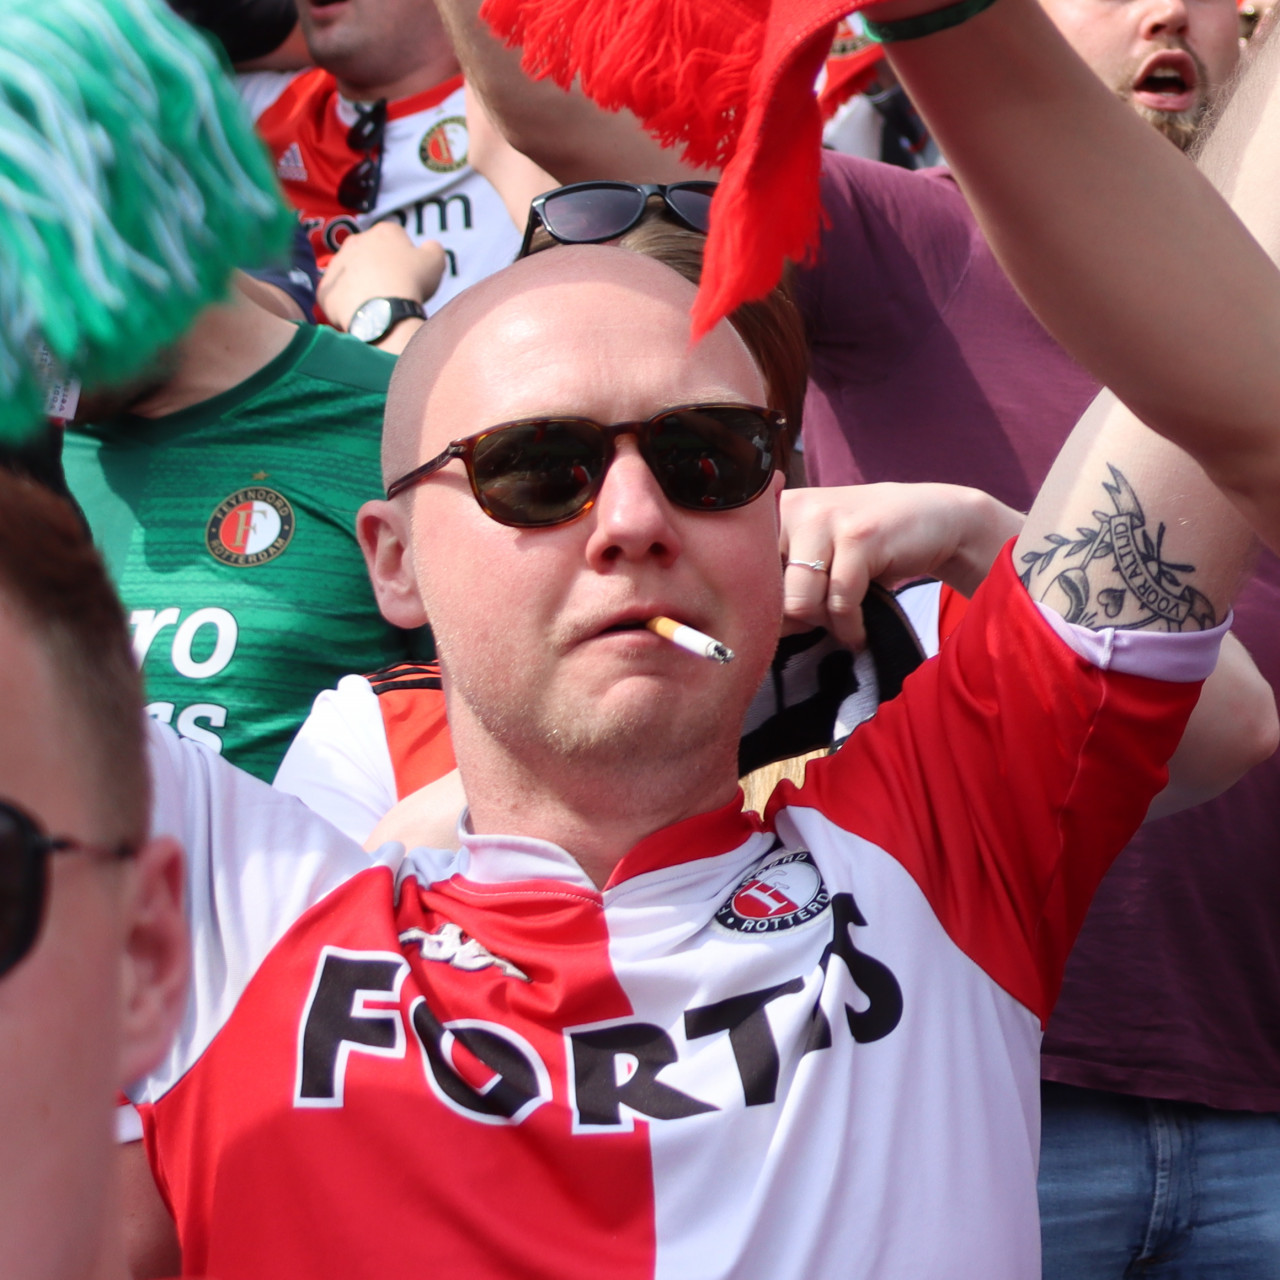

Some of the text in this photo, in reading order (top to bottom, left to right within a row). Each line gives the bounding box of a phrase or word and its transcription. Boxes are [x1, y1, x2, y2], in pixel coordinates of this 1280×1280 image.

[216, 490, 289, 519] FEYENOORD
[210, 537, 286, 564] ROTTERDAM
[1114, 522, 1181, 618] VOOR ALTIJD
